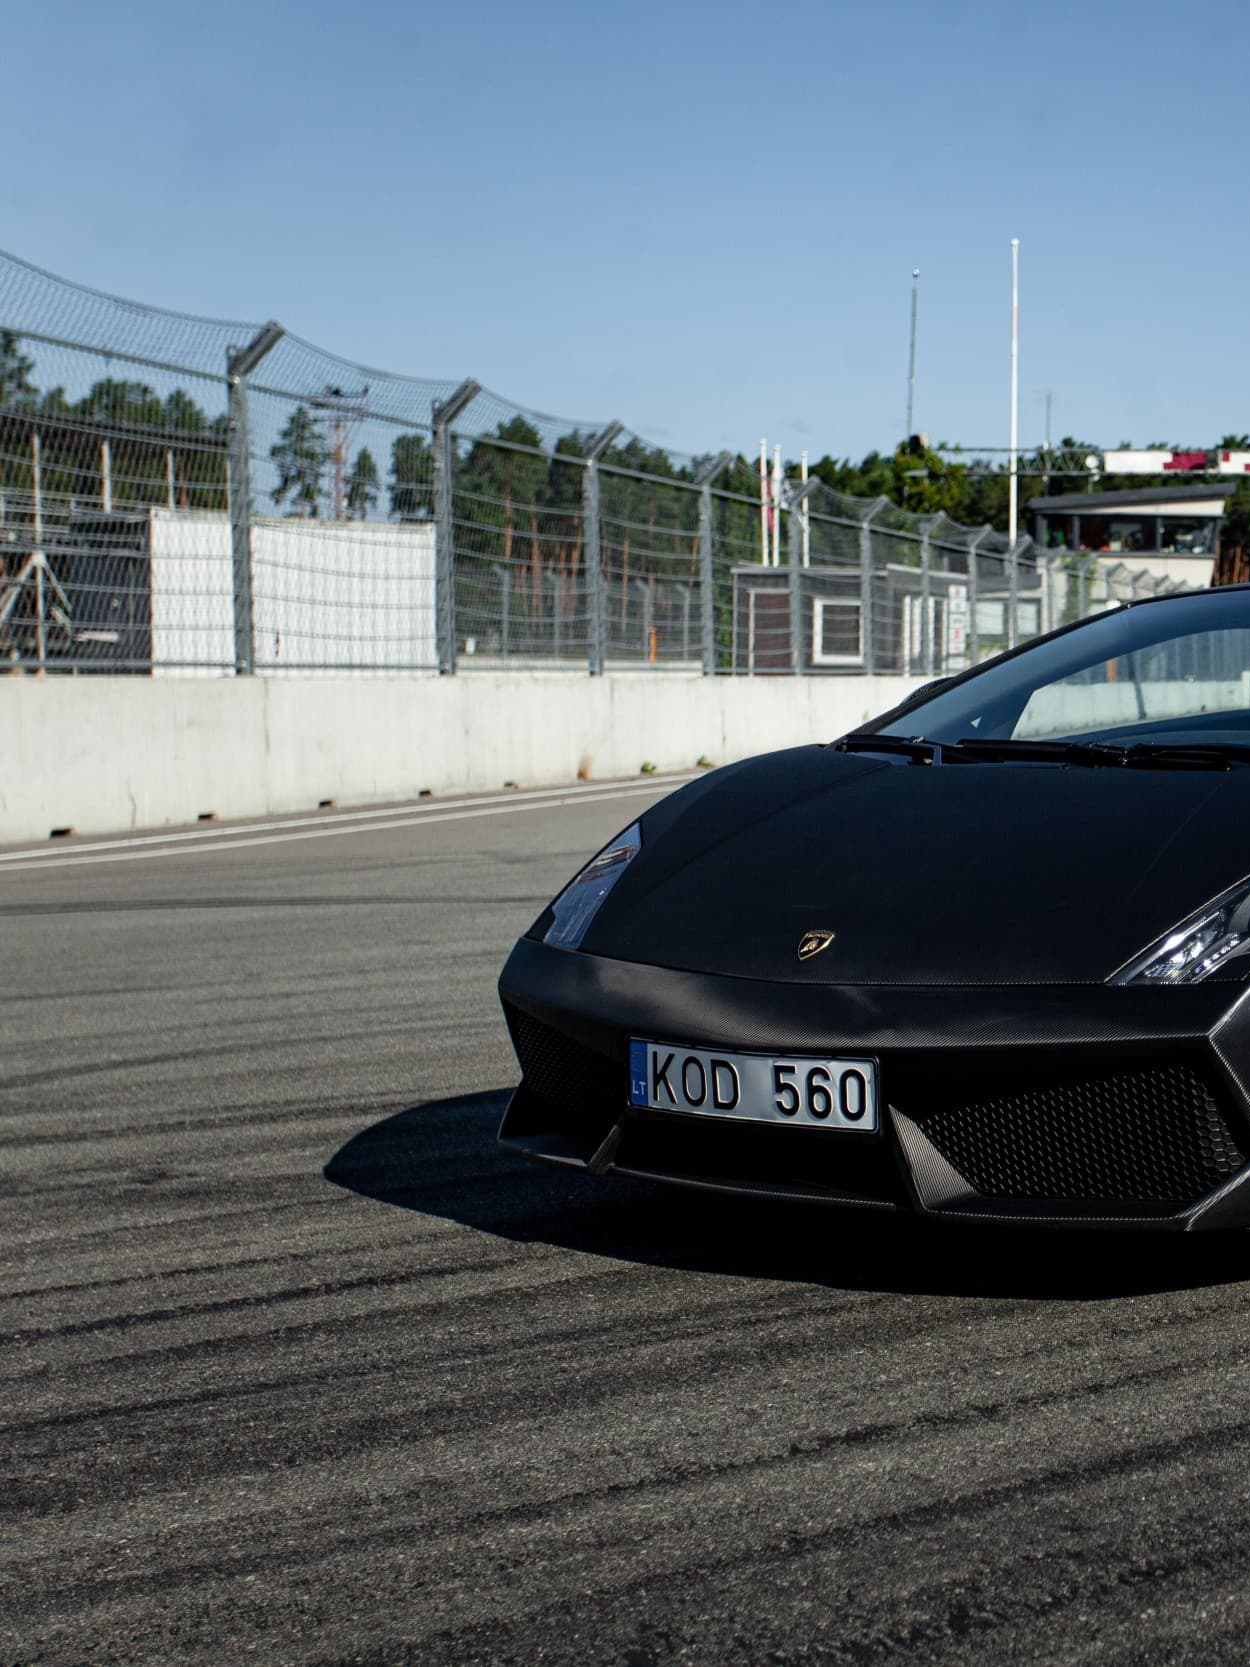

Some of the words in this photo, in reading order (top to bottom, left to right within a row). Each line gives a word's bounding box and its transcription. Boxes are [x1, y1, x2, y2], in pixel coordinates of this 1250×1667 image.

[632, 1079, 646, 1096] LT
[652, 1050, 740, 1110] KOD
[773, 1064, 868, 1121] 560
